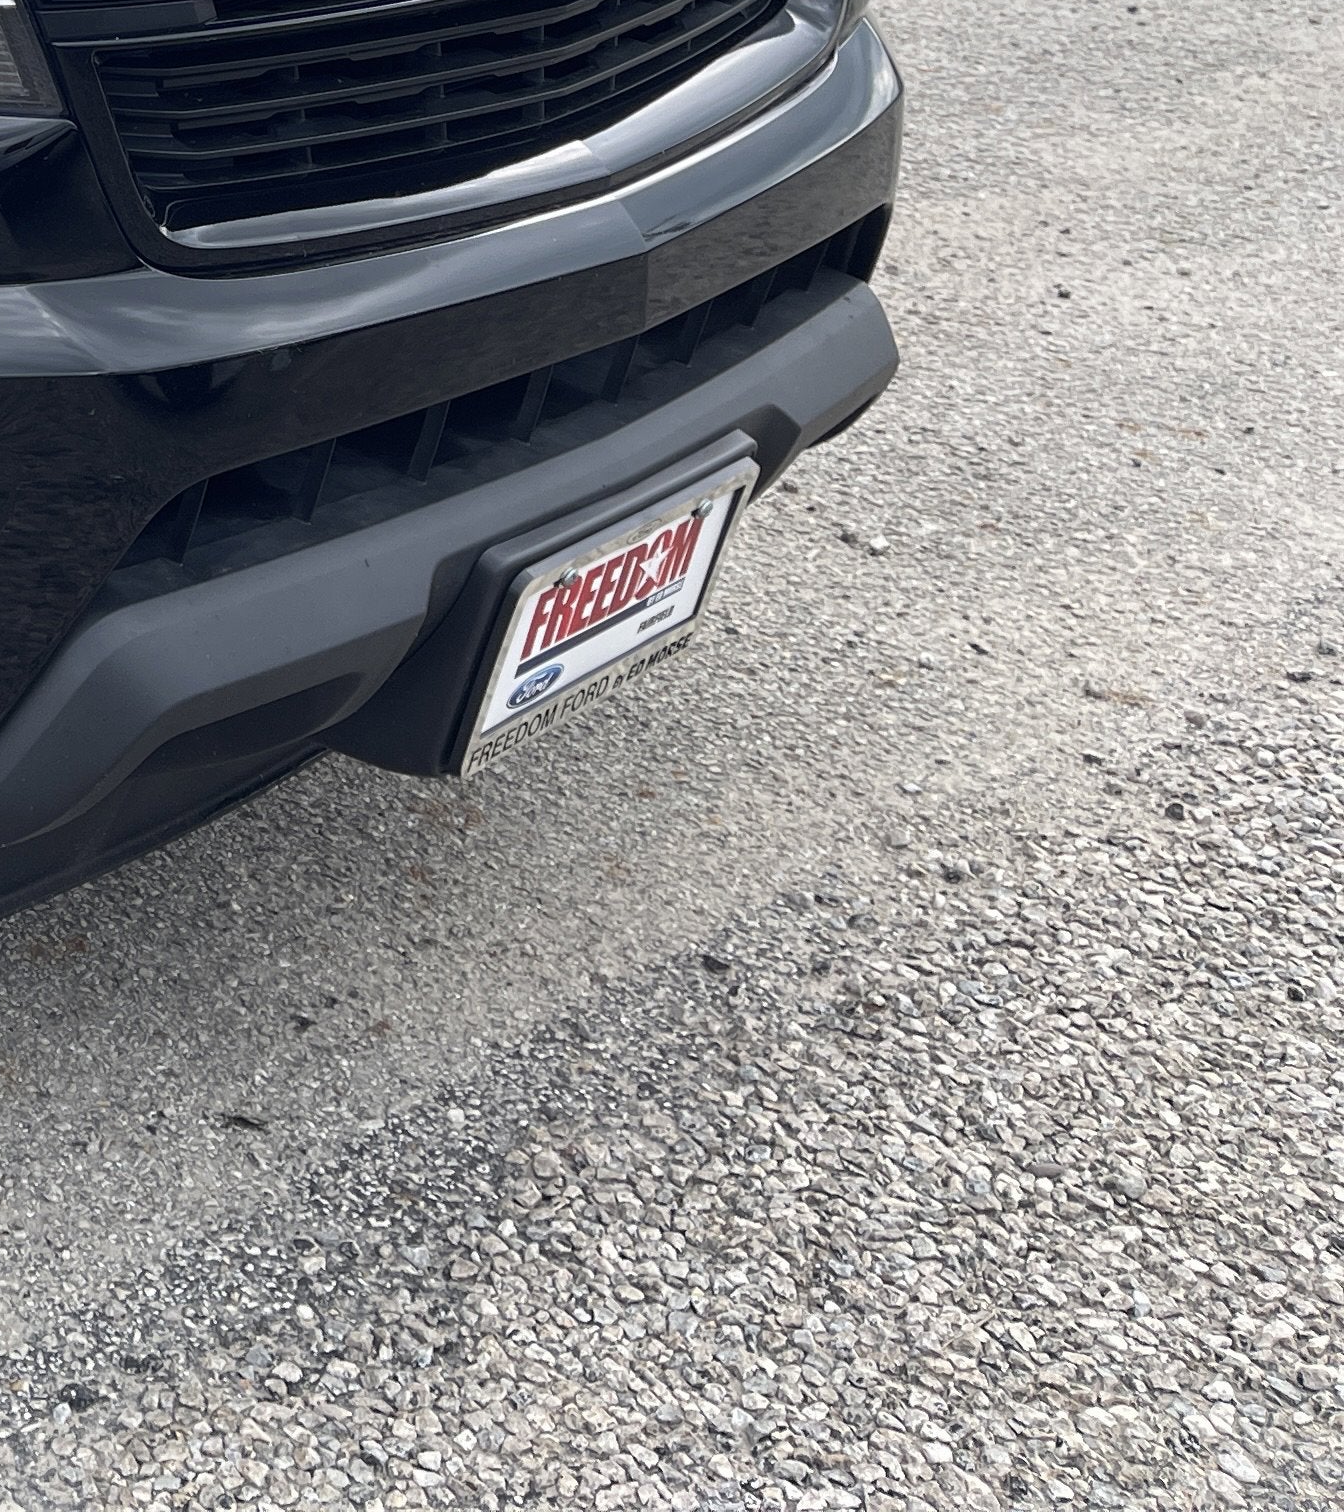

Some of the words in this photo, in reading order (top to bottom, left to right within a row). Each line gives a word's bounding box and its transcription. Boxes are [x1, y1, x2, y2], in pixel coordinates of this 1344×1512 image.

[519, 517, 705, 662] FREEDOM
[467, 704, 558, 774] FREEDOM
[559, 675, 610, 719] FORD
[626, 664, 645, 682] ED
[644, 632, 695, 671] MORSE
[515, 671, 555, 705] Ford
